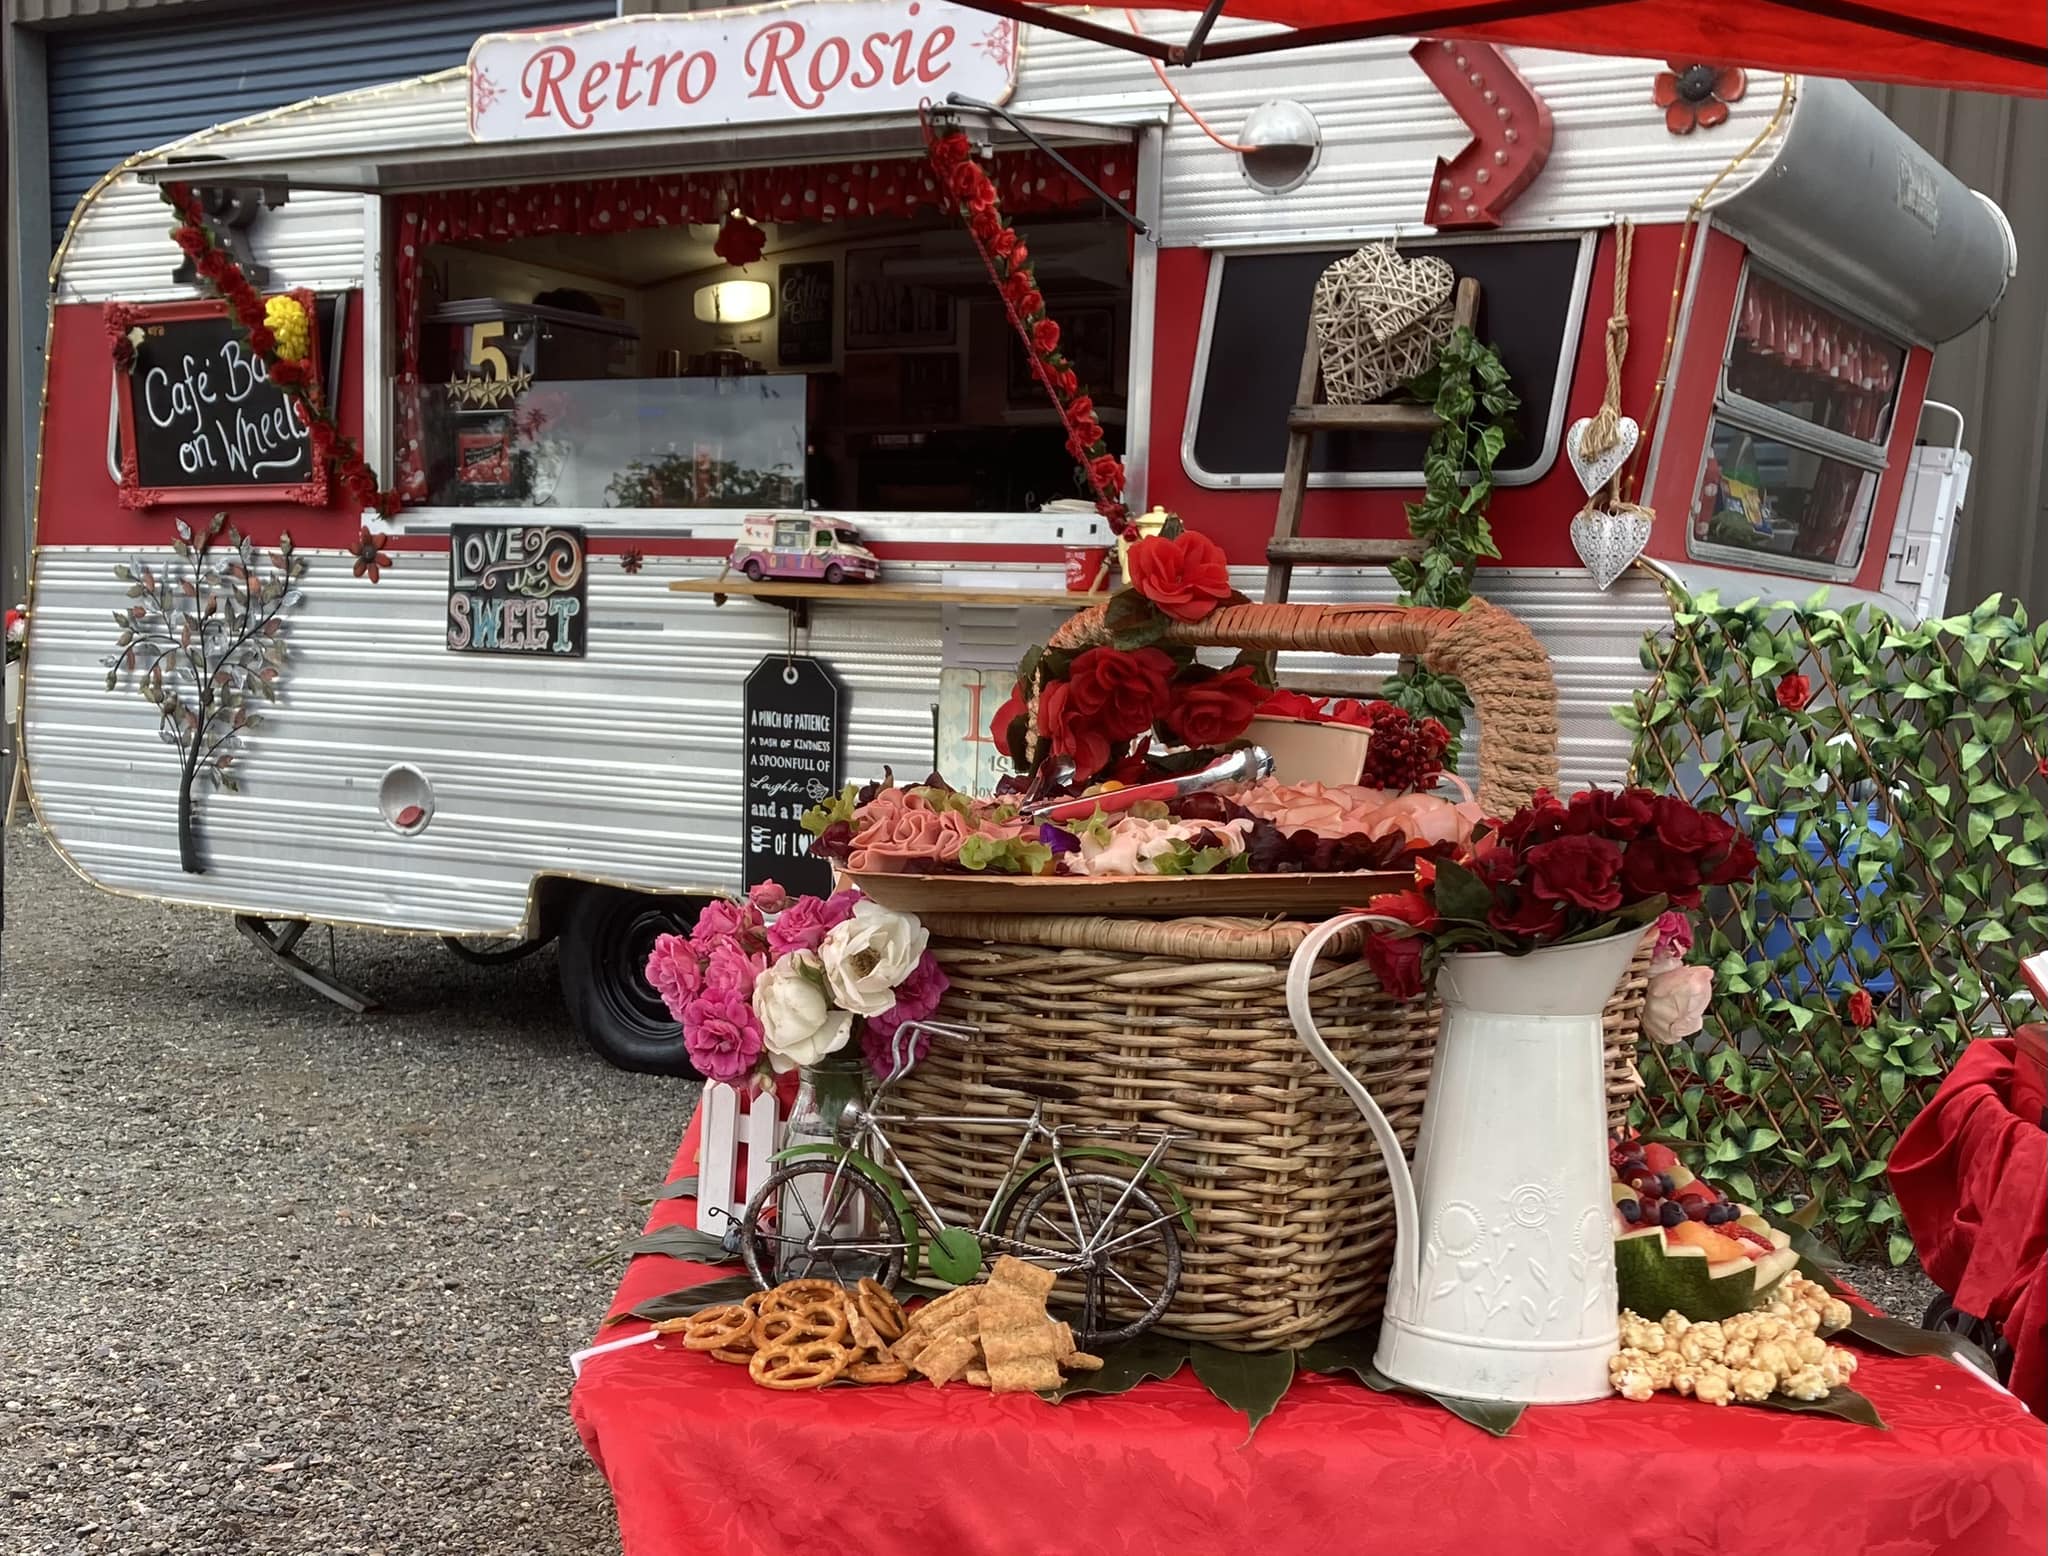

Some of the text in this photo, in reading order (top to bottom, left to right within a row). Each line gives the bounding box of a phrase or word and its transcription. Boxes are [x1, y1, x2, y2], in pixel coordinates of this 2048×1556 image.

[521, 3, 955, 130] Retro Rosie
[145, 340, 271, 434] Café Ba
[179, 393, 310, 473] on Wheels
[452, 527, 524, 590] LOVE
[447, 592, 580, 653] SWEET
[751, 709, 830, 732] A PINCH OF PATIENCE
[750, 737, 830, 752] A DASH OF KINDNESS
[750, 754, 831, 773] A SPOONFULL OF
[750, 775, 806, 797] Laughter
[751, 802, 776, 818] and
[781, 806, 788, 819] a
